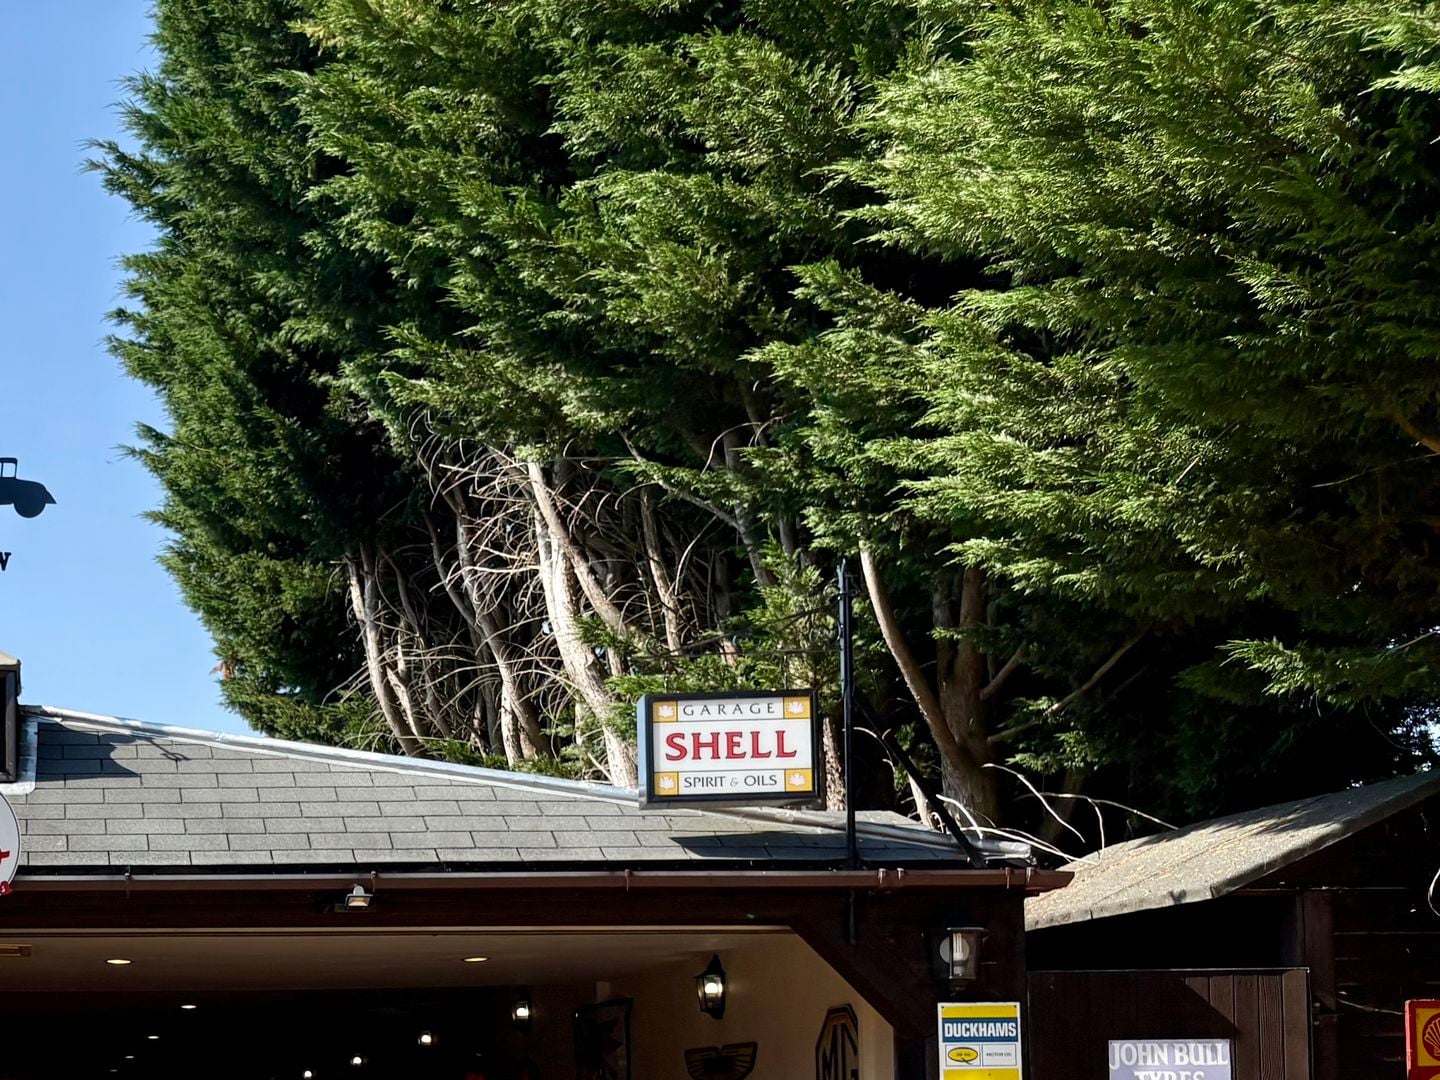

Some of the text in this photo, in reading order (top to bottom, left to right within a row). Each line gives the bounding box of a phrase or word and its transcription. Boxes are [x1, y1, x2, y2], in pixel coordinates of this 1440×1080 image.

[683, 703, 775, 716] GARAGE
[665, 730, 797, 761] SHELL
[684, 776, 725, 788] SPIRIT
[744, 775, 777, 786] OILS
[944, 1022, 1016, 1038] DUCKHAMS
[1109, 1043, 1229, 1070] JOHN BULL
